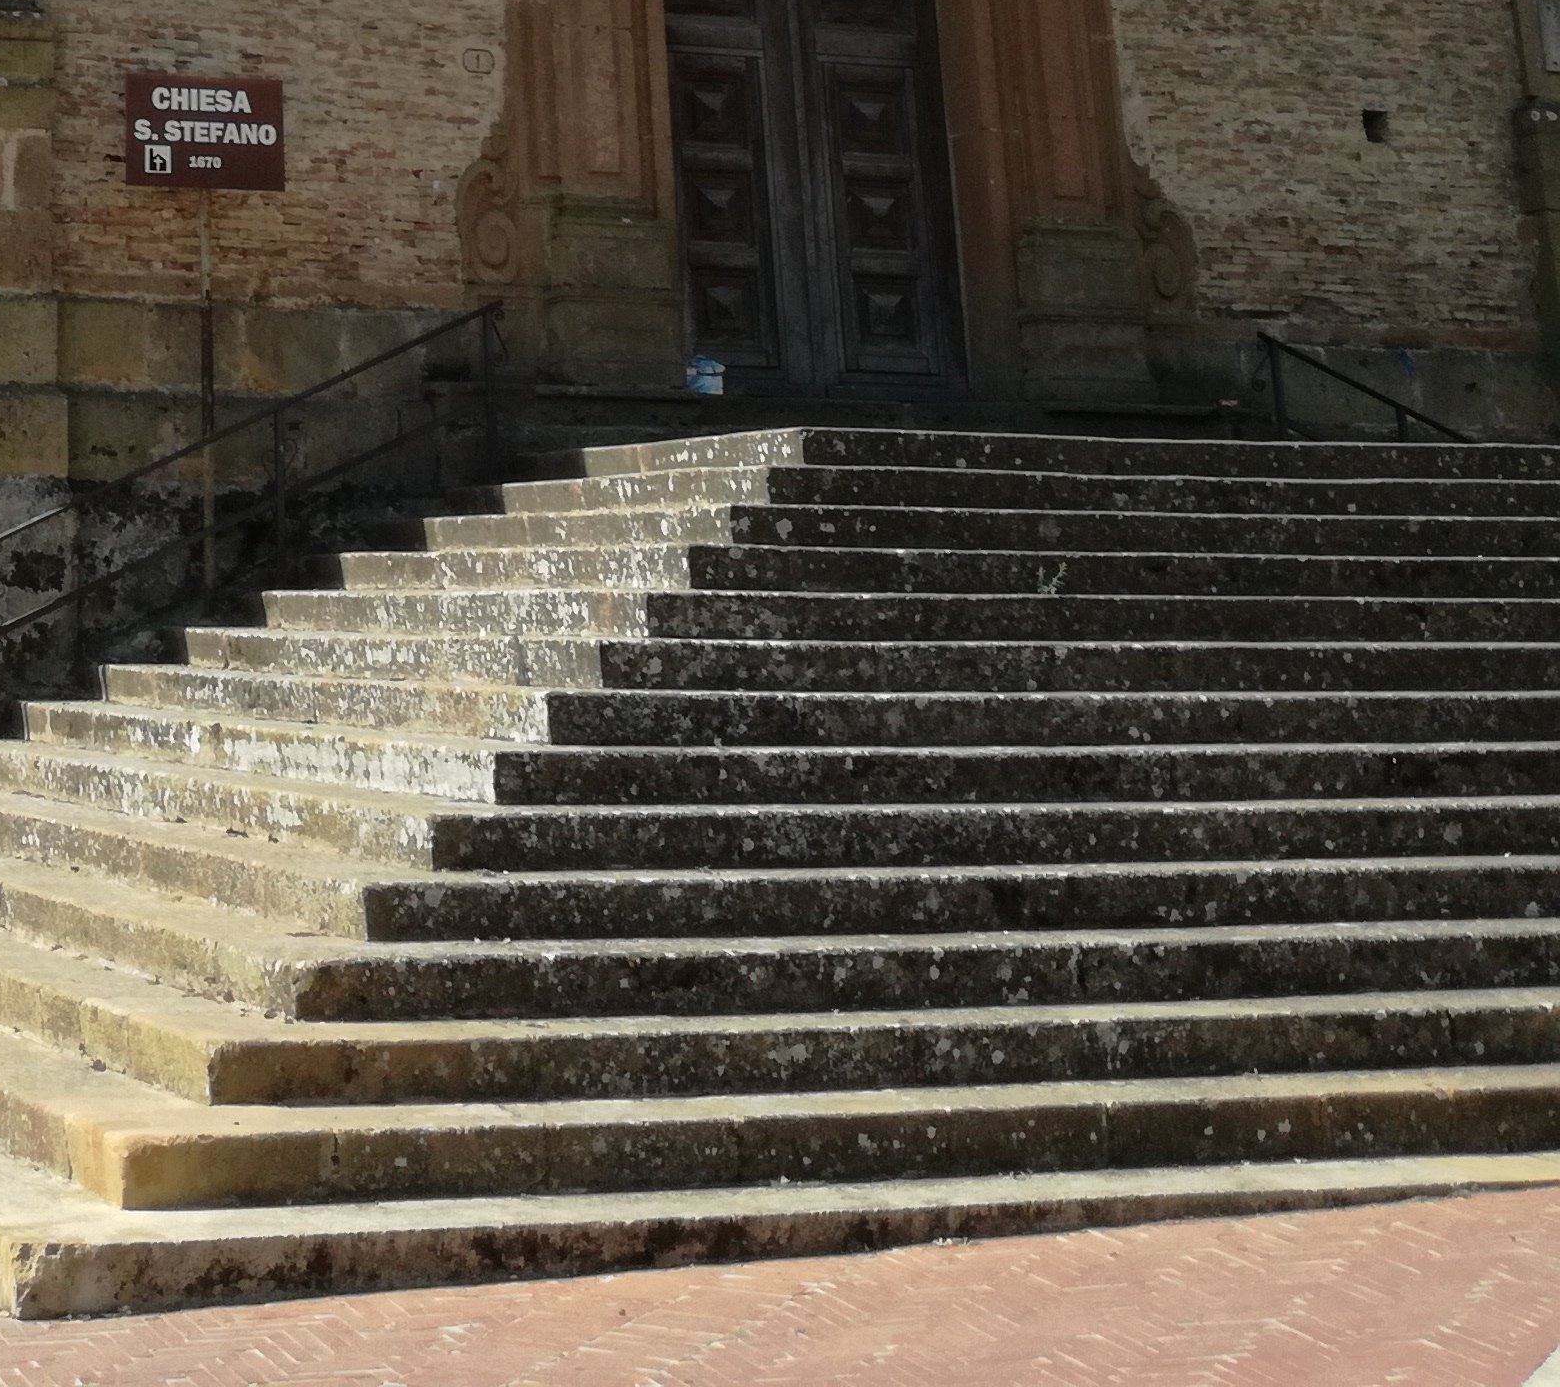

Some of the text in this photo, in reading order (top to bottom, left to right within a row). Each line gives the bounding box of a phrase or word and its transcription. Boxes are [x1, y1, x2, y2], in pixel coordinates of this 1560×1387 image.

[151, 86, 253, 114] CHIESA
[133, 118, 278, 146] S. STEFANO
[188, 155, 222, 170] 1670
